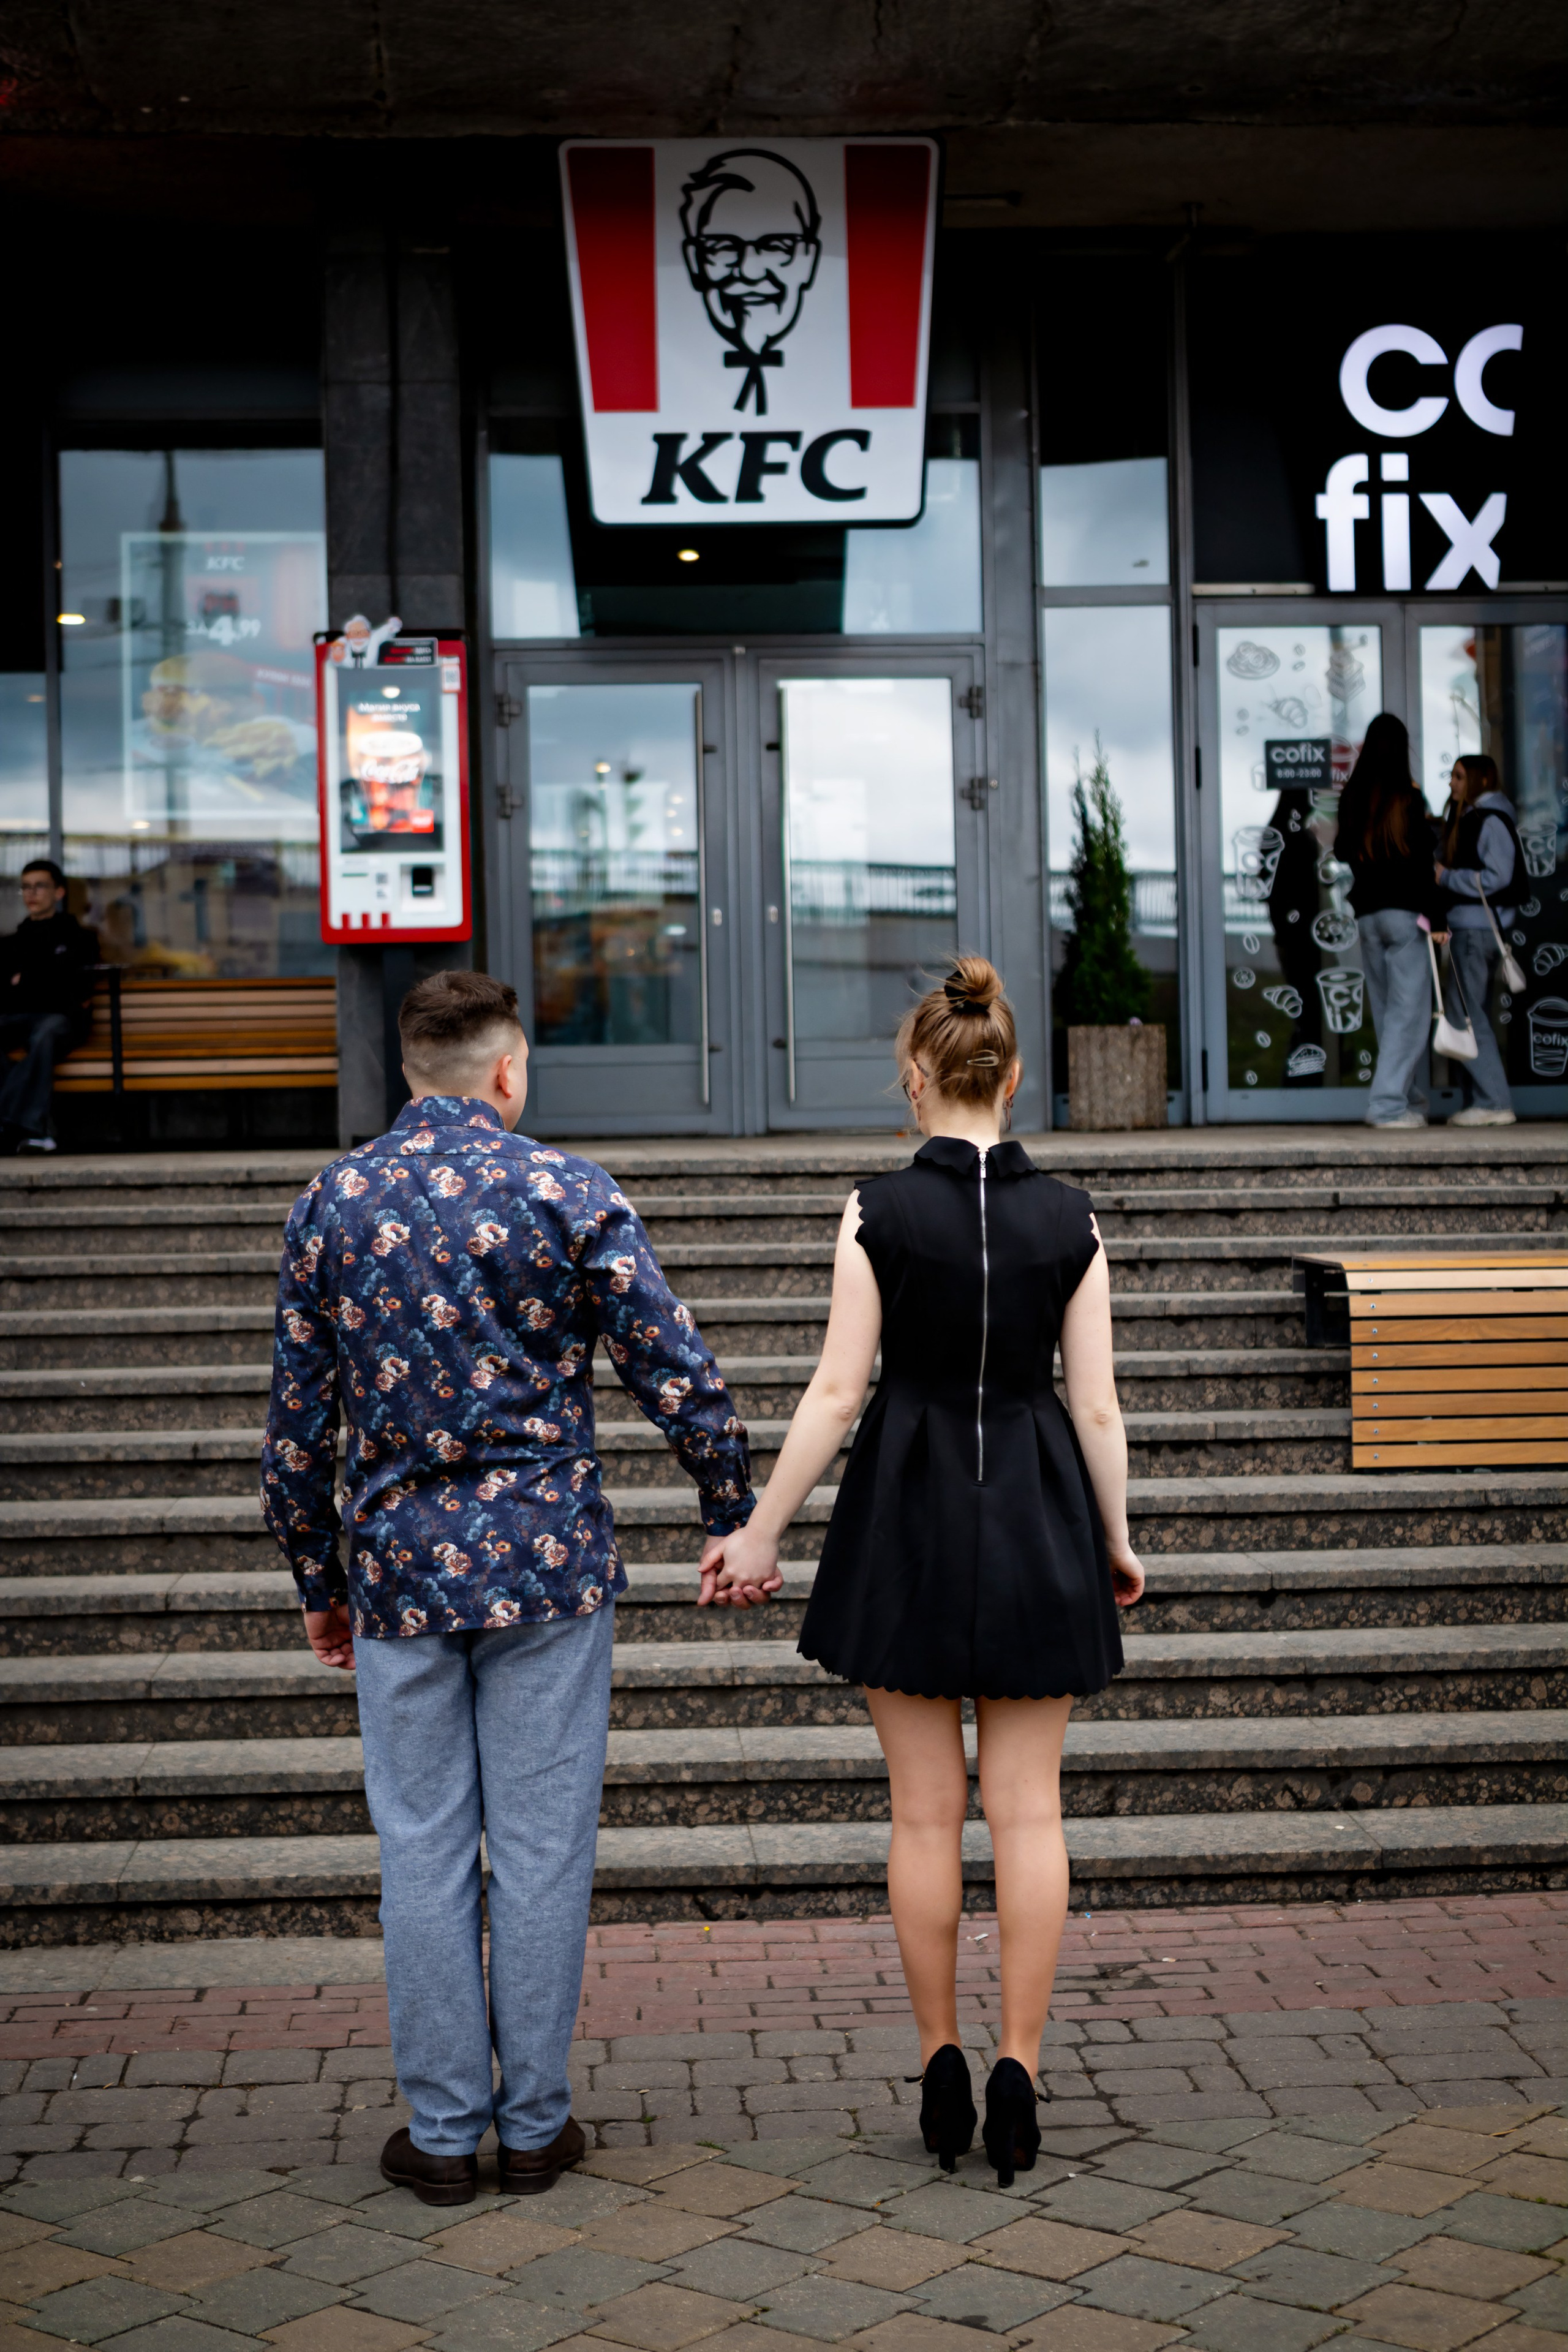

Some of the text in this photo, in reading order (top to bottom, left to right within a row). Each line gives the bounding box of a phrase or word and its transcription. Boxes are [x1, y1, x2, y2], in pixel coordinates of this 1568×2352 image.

[641, 428, 872, 505] KFC
[1316, 453, 1507, 592] fix
[206, 556, 245, 571] KFC
[1270, 742, 1326, 763] cofix
